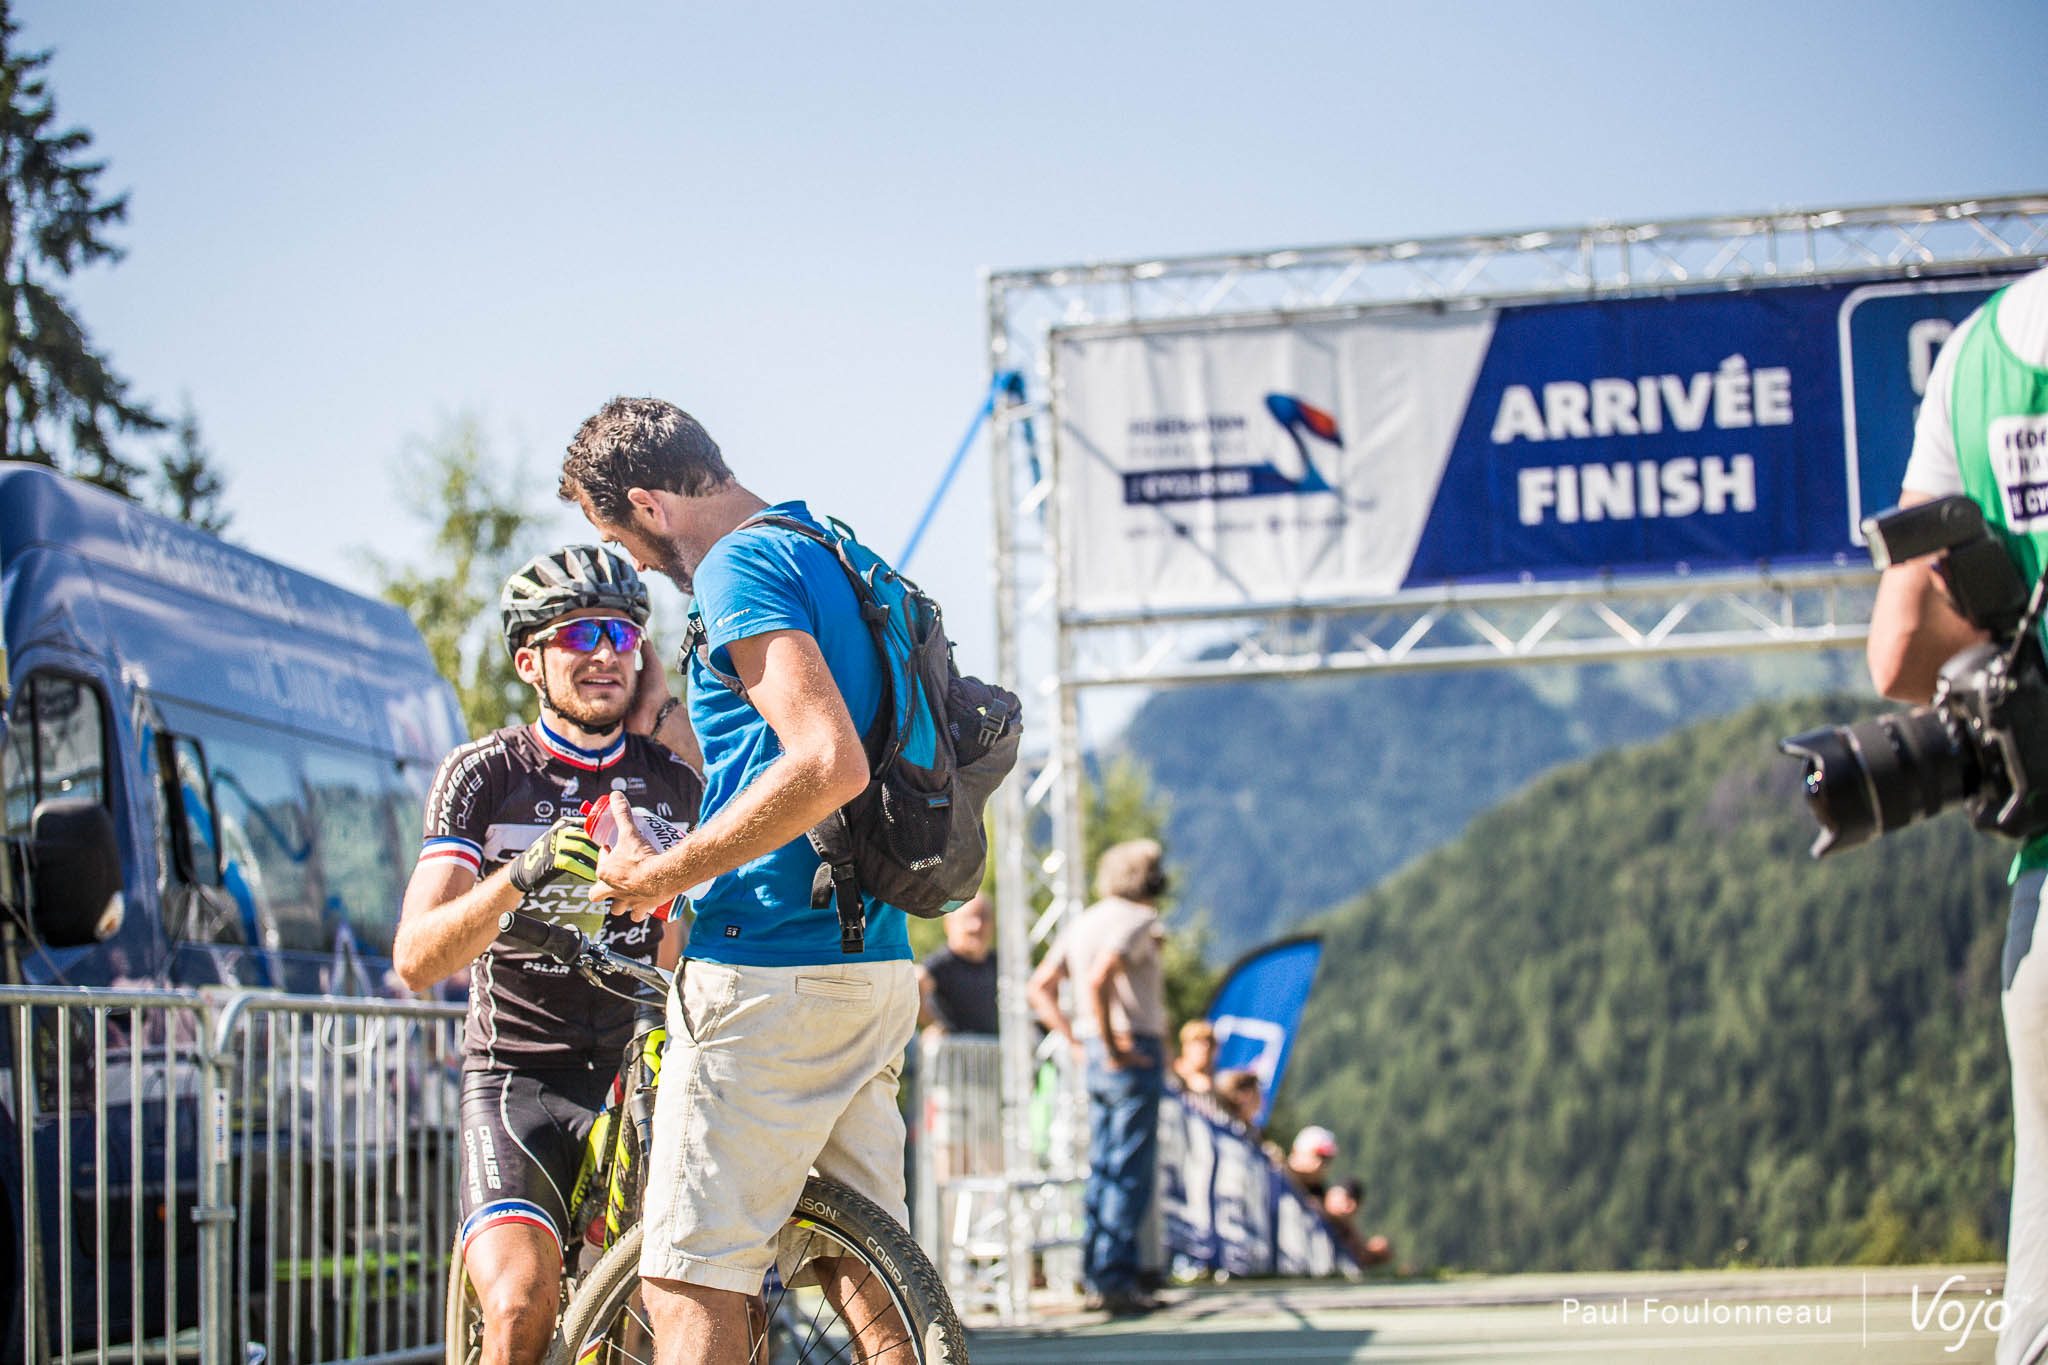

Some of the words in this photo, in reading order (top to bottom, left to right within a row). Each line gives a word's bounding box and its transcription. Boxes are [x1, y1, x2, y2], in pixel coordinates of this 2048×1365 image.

[1490, 354, 1792, 443] ARRIVÉE
[1517, 454, 1756, 526] FINISH
[523, 961, 571, 975] POLAR
[866, 1236, 908, 1297] COBRA
